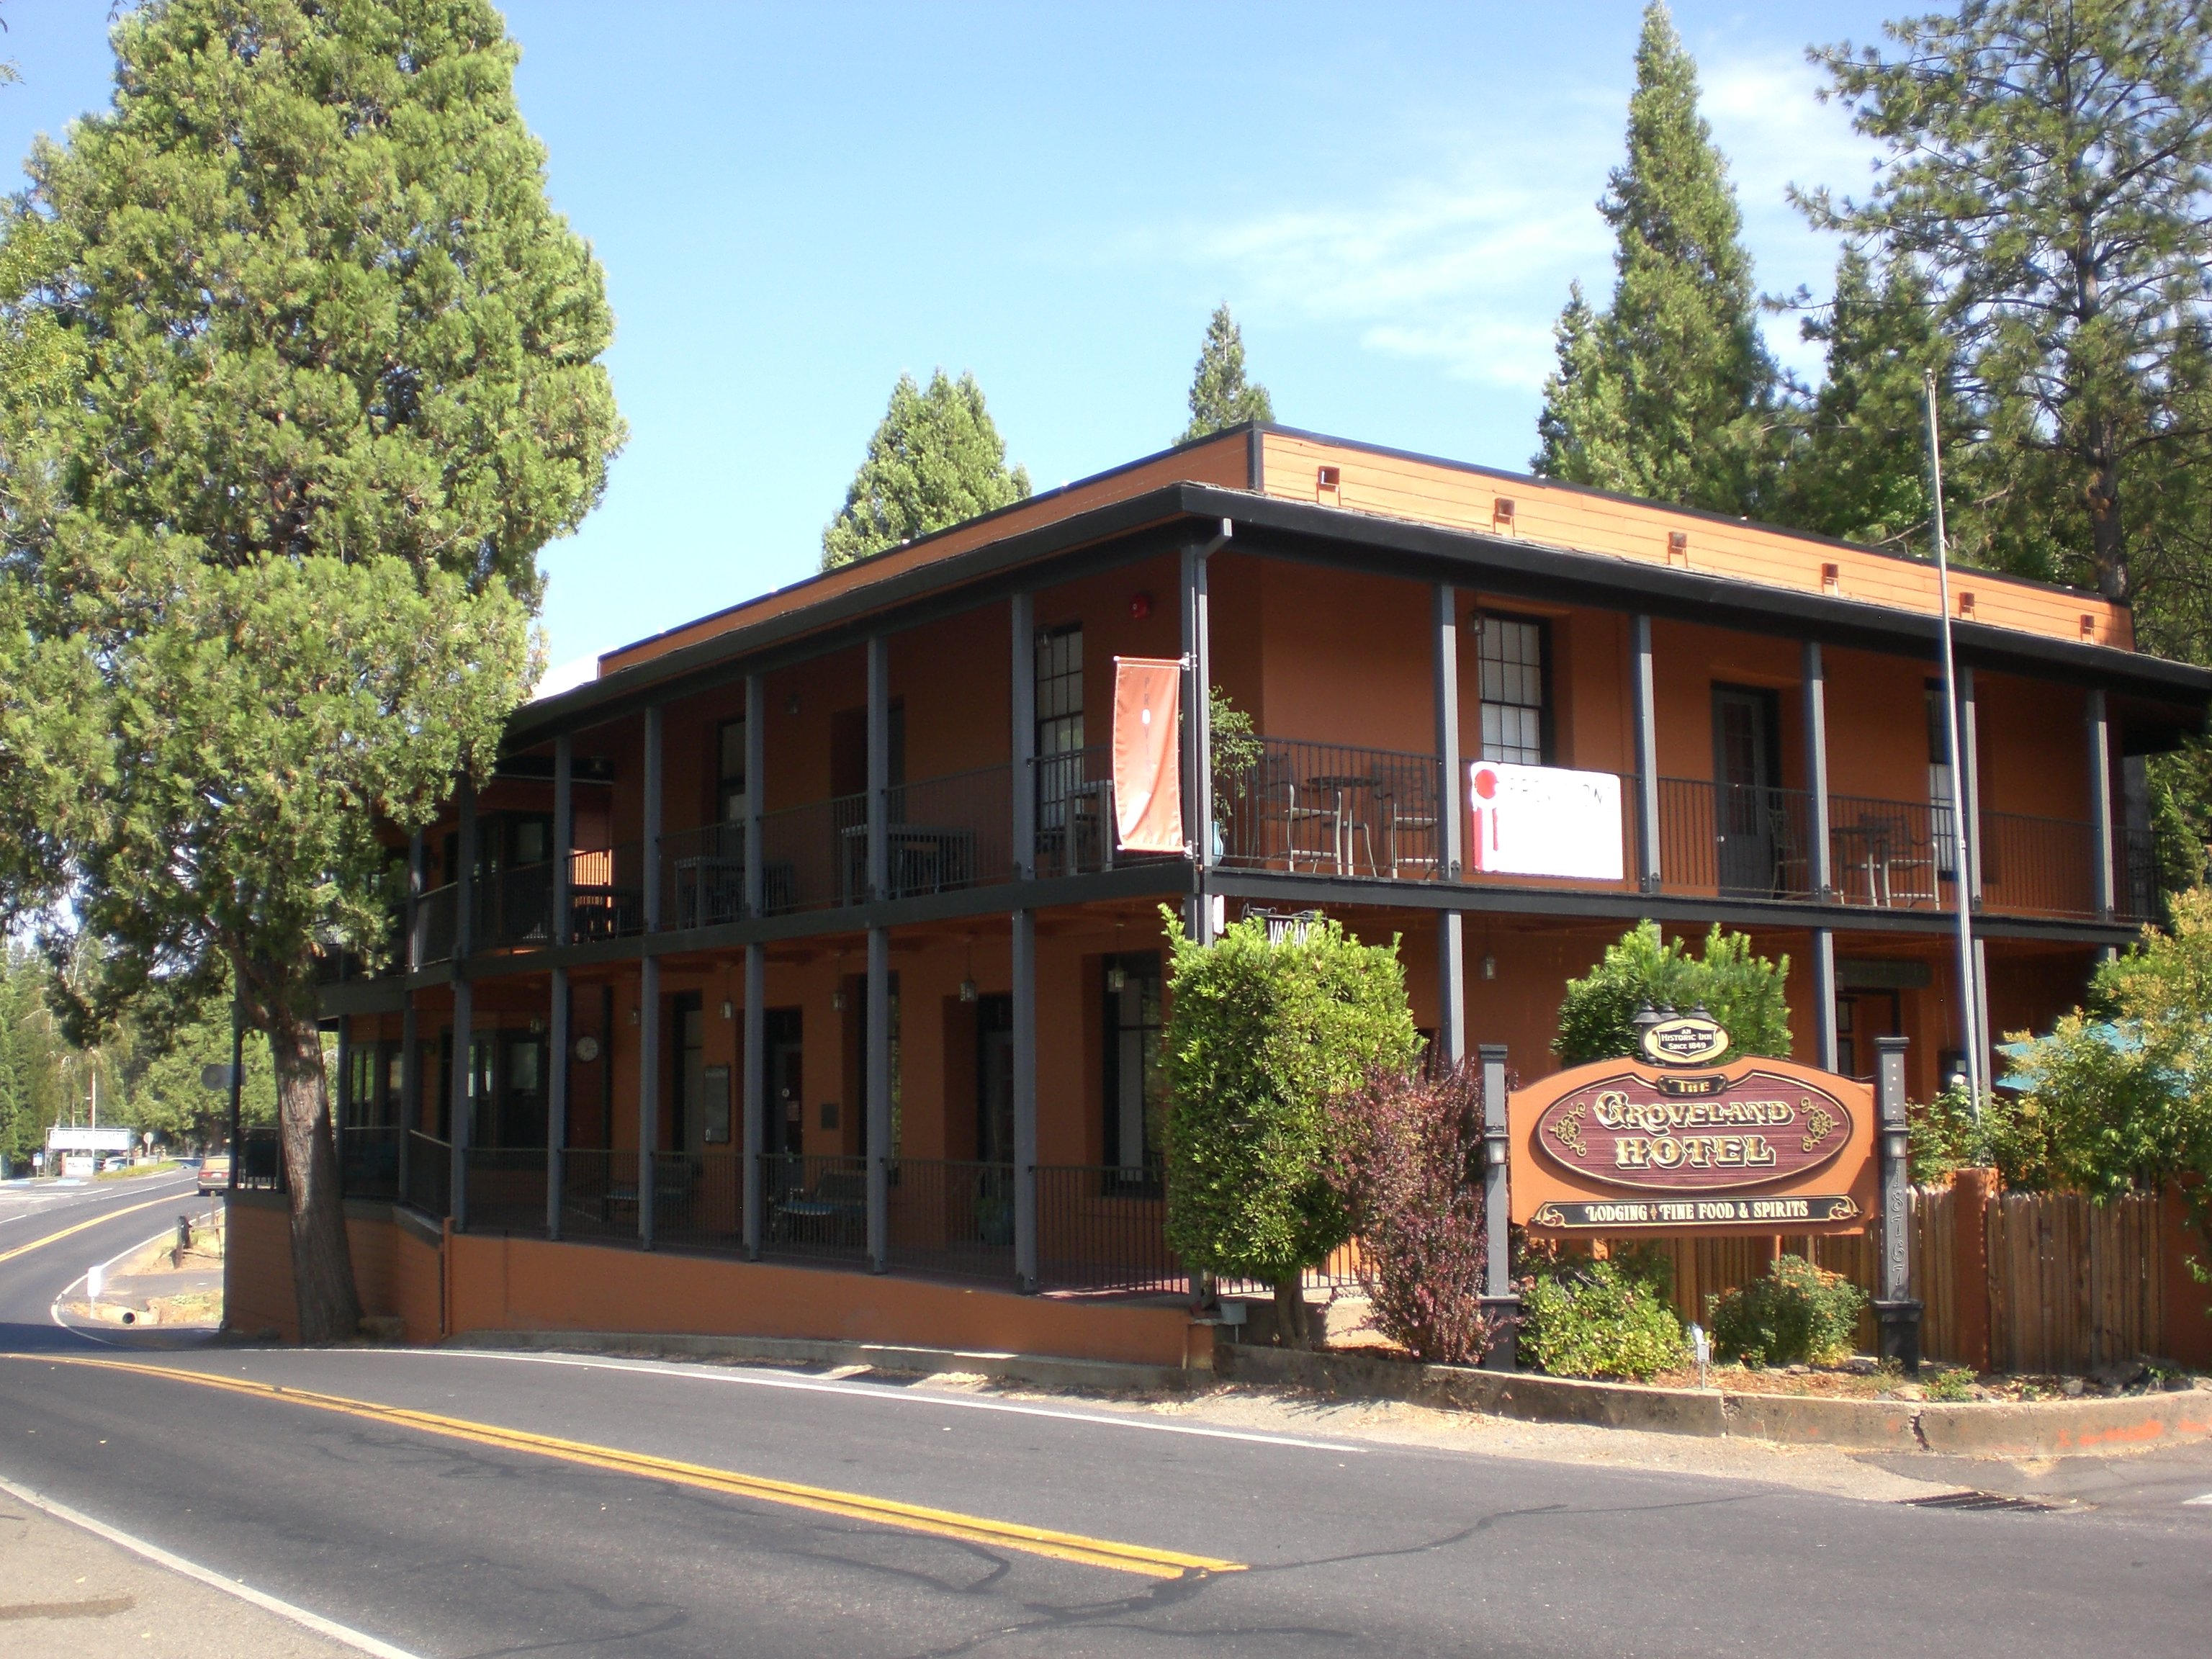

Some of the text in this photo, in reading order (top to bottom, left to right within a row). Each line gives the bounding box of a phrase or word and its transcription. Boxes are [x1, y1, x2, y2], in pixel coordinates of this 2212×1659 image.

[1668, 1079, 1710, 1092] THE
[1593, 1091, 1796, 1136] GROVELAND
[1614, 1136, 1777, 1170] HOTEL
[1585, 1200, 1809, 1222] LODGING FINE FOOD & SPIRITS
[1891, 1165, 1905, 1287] 18767
